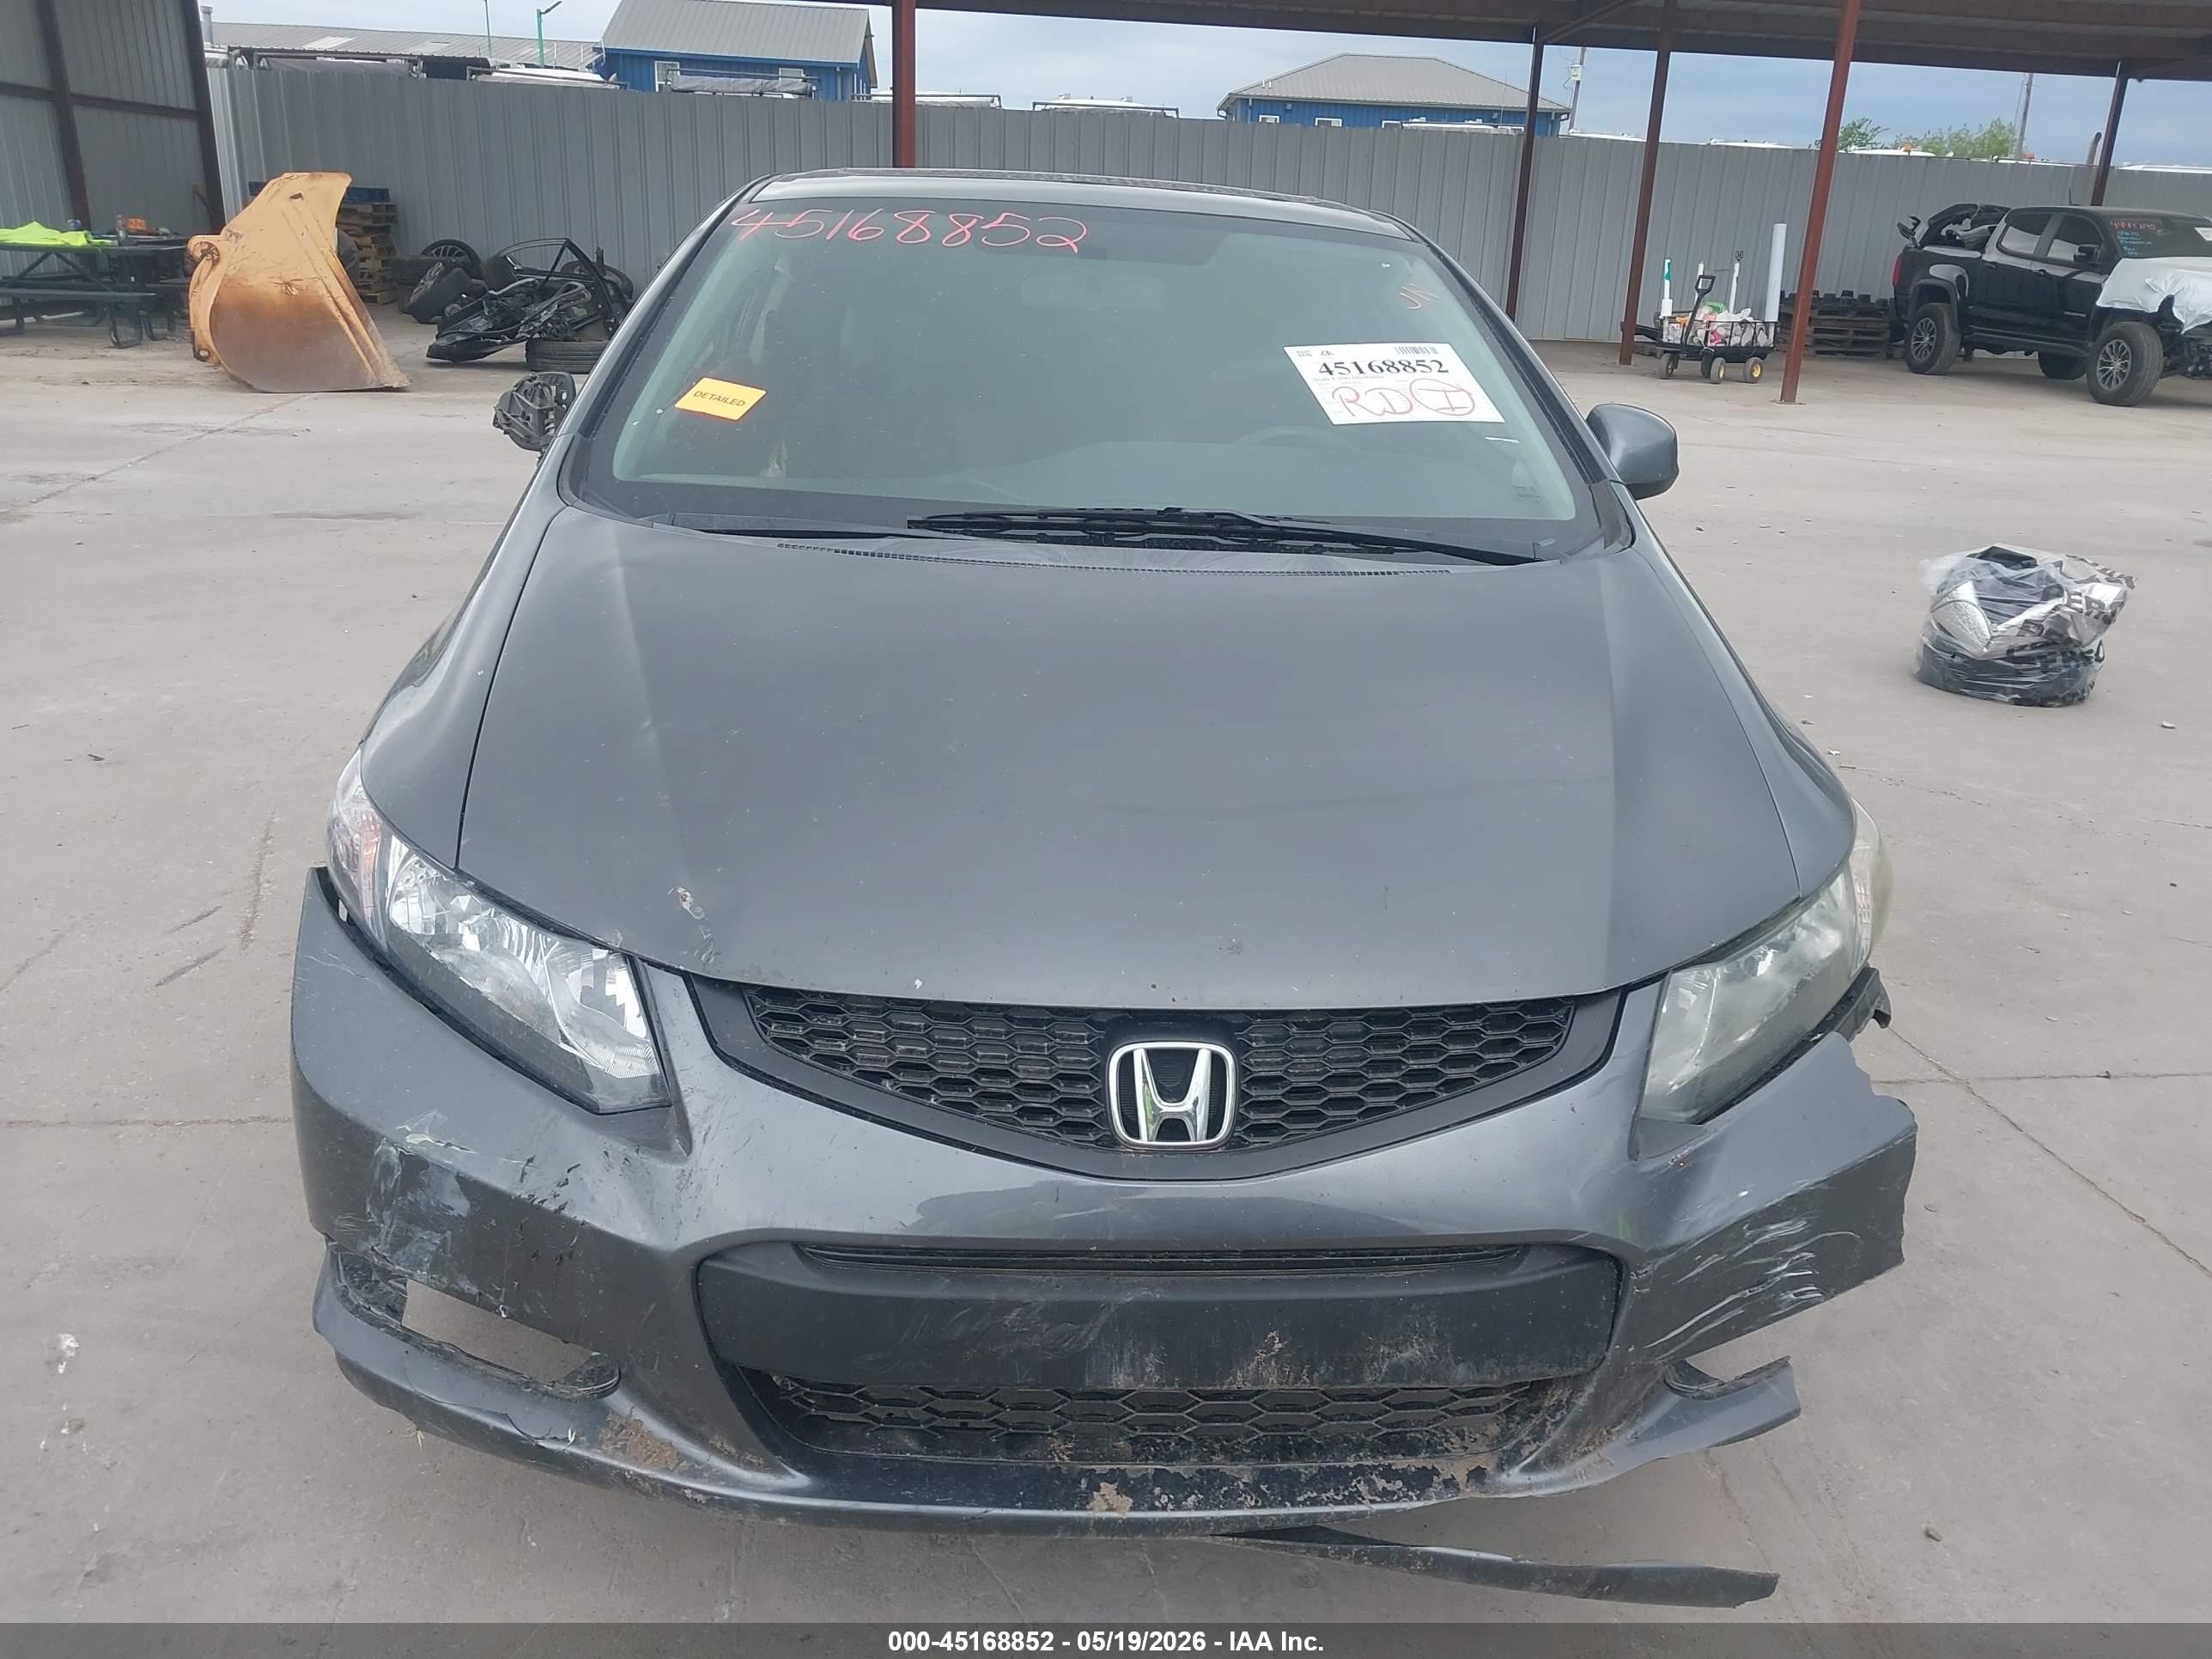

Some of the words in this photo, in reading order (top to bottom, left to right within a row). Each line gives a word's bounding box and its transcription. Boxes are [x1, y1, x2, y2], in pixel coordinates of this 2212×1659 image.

[731, 207, 1088, 254] 45168852
[1318, 358, 1449, 376] 45168852
[693, 391, 746, 407] DETAILED
